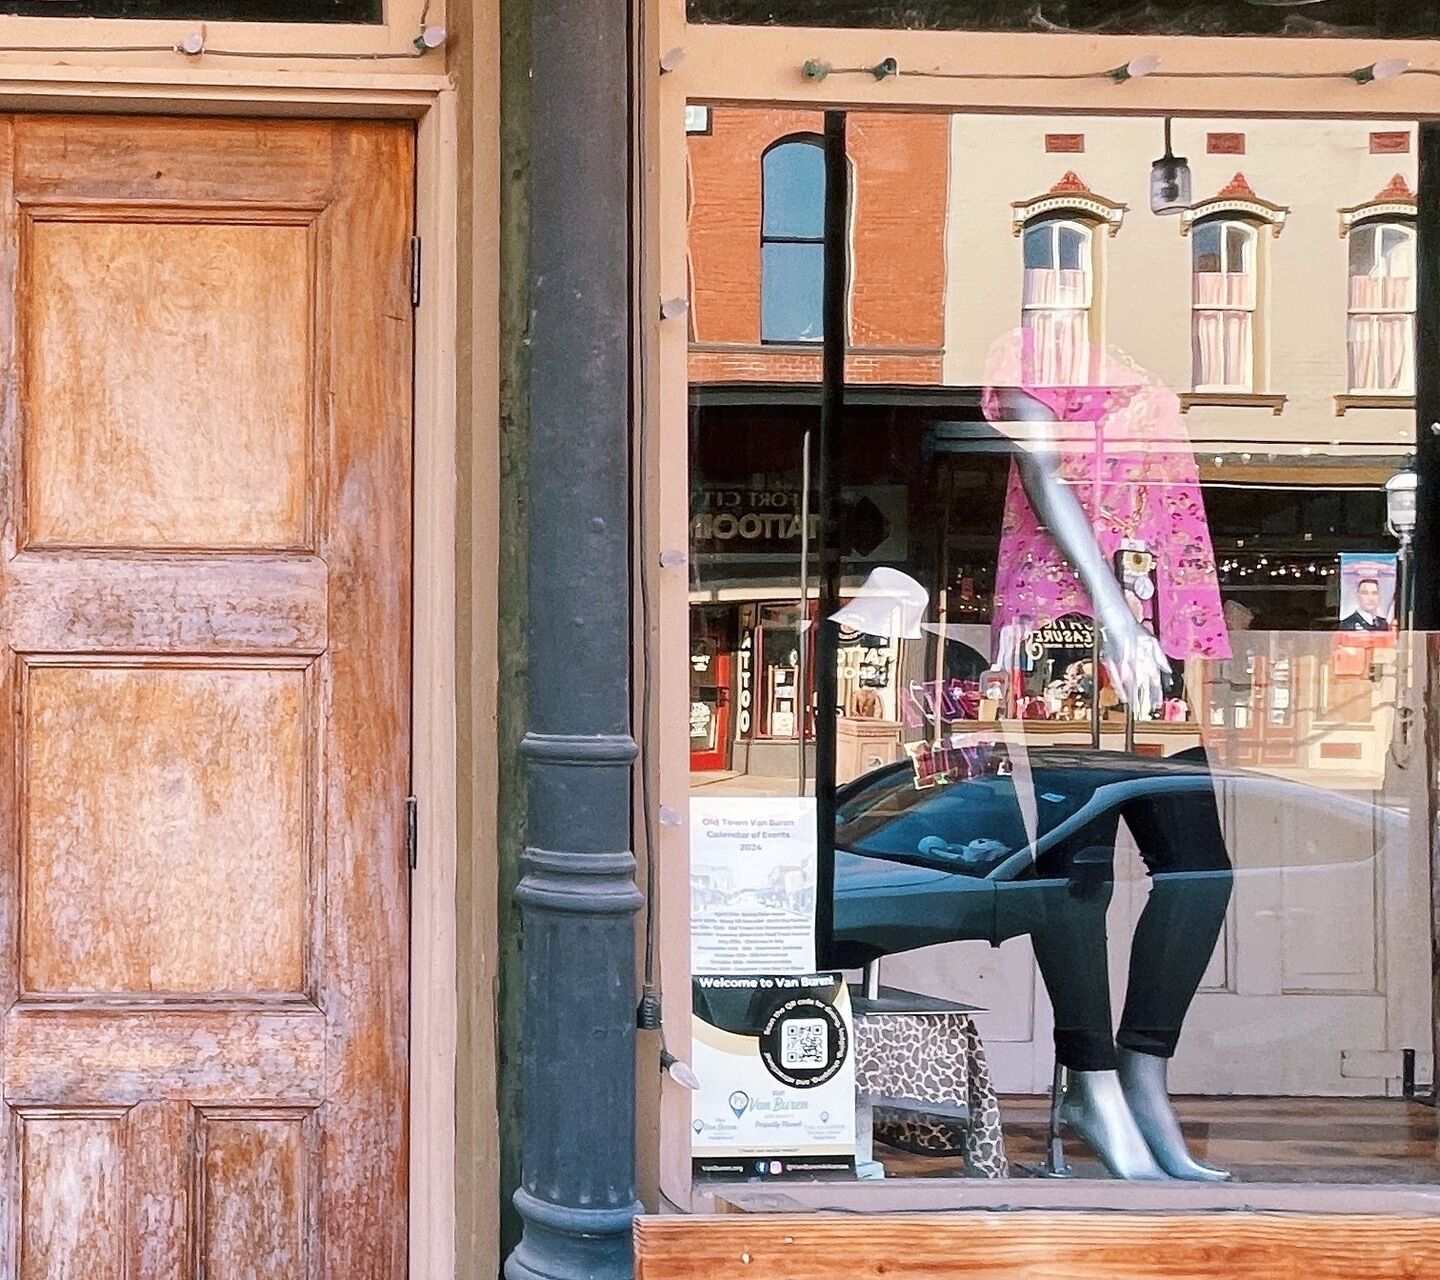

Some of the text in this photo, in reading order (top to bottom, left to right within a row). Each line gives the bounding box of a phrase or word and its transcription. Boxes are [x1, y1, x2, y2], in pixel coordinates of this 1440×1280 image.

[706, 830, 749, 839] Calendar
[762, 831, 791, 839] Events
[699, 977, 759, 989] Welcome
[760, 978, 774, 988] to
[775, 977, 800, 988] Van
